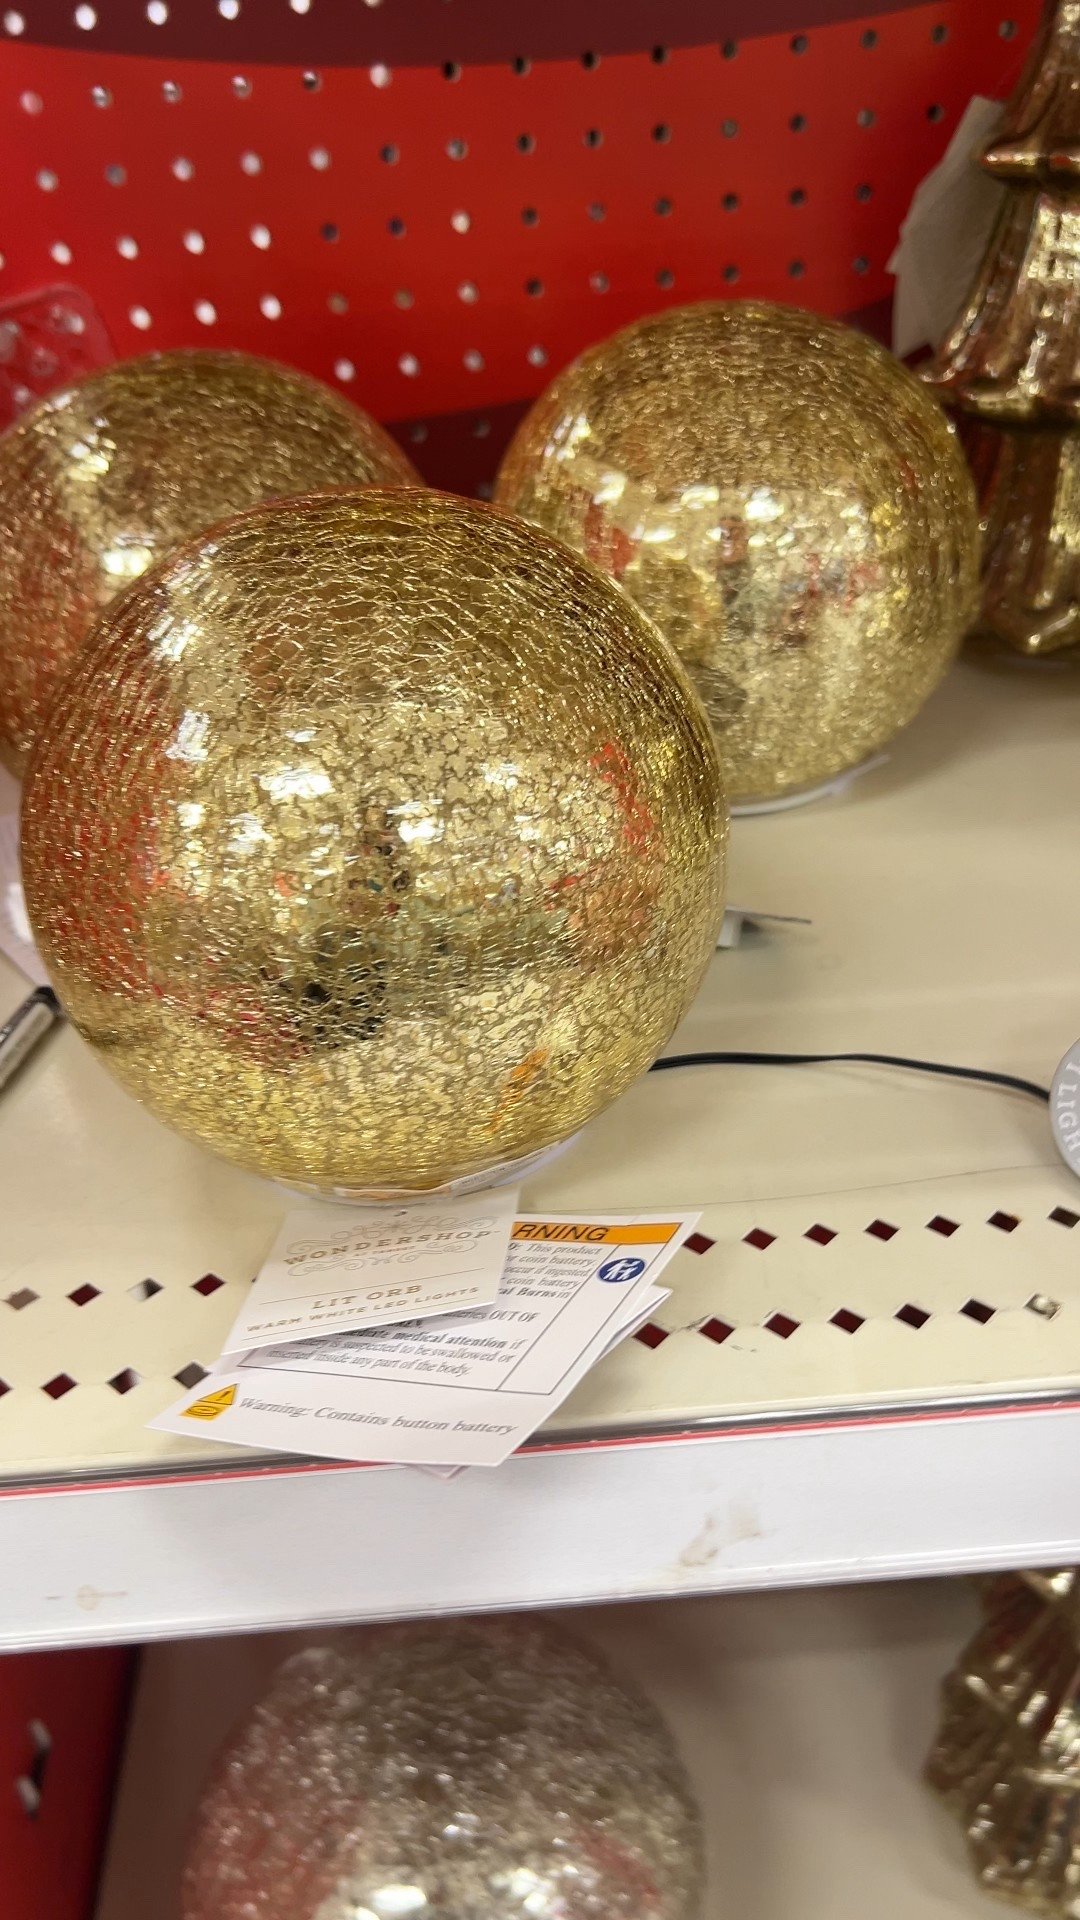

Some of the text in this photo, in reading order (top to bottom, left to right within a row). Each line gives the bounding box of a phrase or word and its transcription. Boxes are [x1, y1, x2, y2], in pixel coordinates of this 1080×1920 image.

[1057, 1082, 1080, 1166] LIGH
[512, 1224, 609, 1241] RNING
[284, 1230, 490, 1265] WONDERSHOP
[526, 1243, 552, 1252] This
[552, 1245, 602, 1255] product
[519, 1255, 547, 1263] coin
[517, 1287, 556, 1297] Burns
[537, 1278, 582, 1290] battery
[312, 1285, 423, 1310] LIT ORB
[246, 1287, 480, 1332] WARM WHITE LED LIGHTS
[488, 1310, 518, 1321] OUT
[517, 1312, 541, 1322] OF
[391, 1331, 448, 1343] medical
[445, 1335, 508, 1349] attention
[509, 1338, 528, 1350] if
[341, 1341, 401, 1353] suspected
[399, 1343, 417, 1354] to
[415, 1345, 432, 1356] be
[430, 1347, 500, 1362] swallowed
[368, 1358, 401, 1369] part
[414, 1359, 439, 1371] the
[240, 1397, 519, 1436] Warning: Contains button battery
